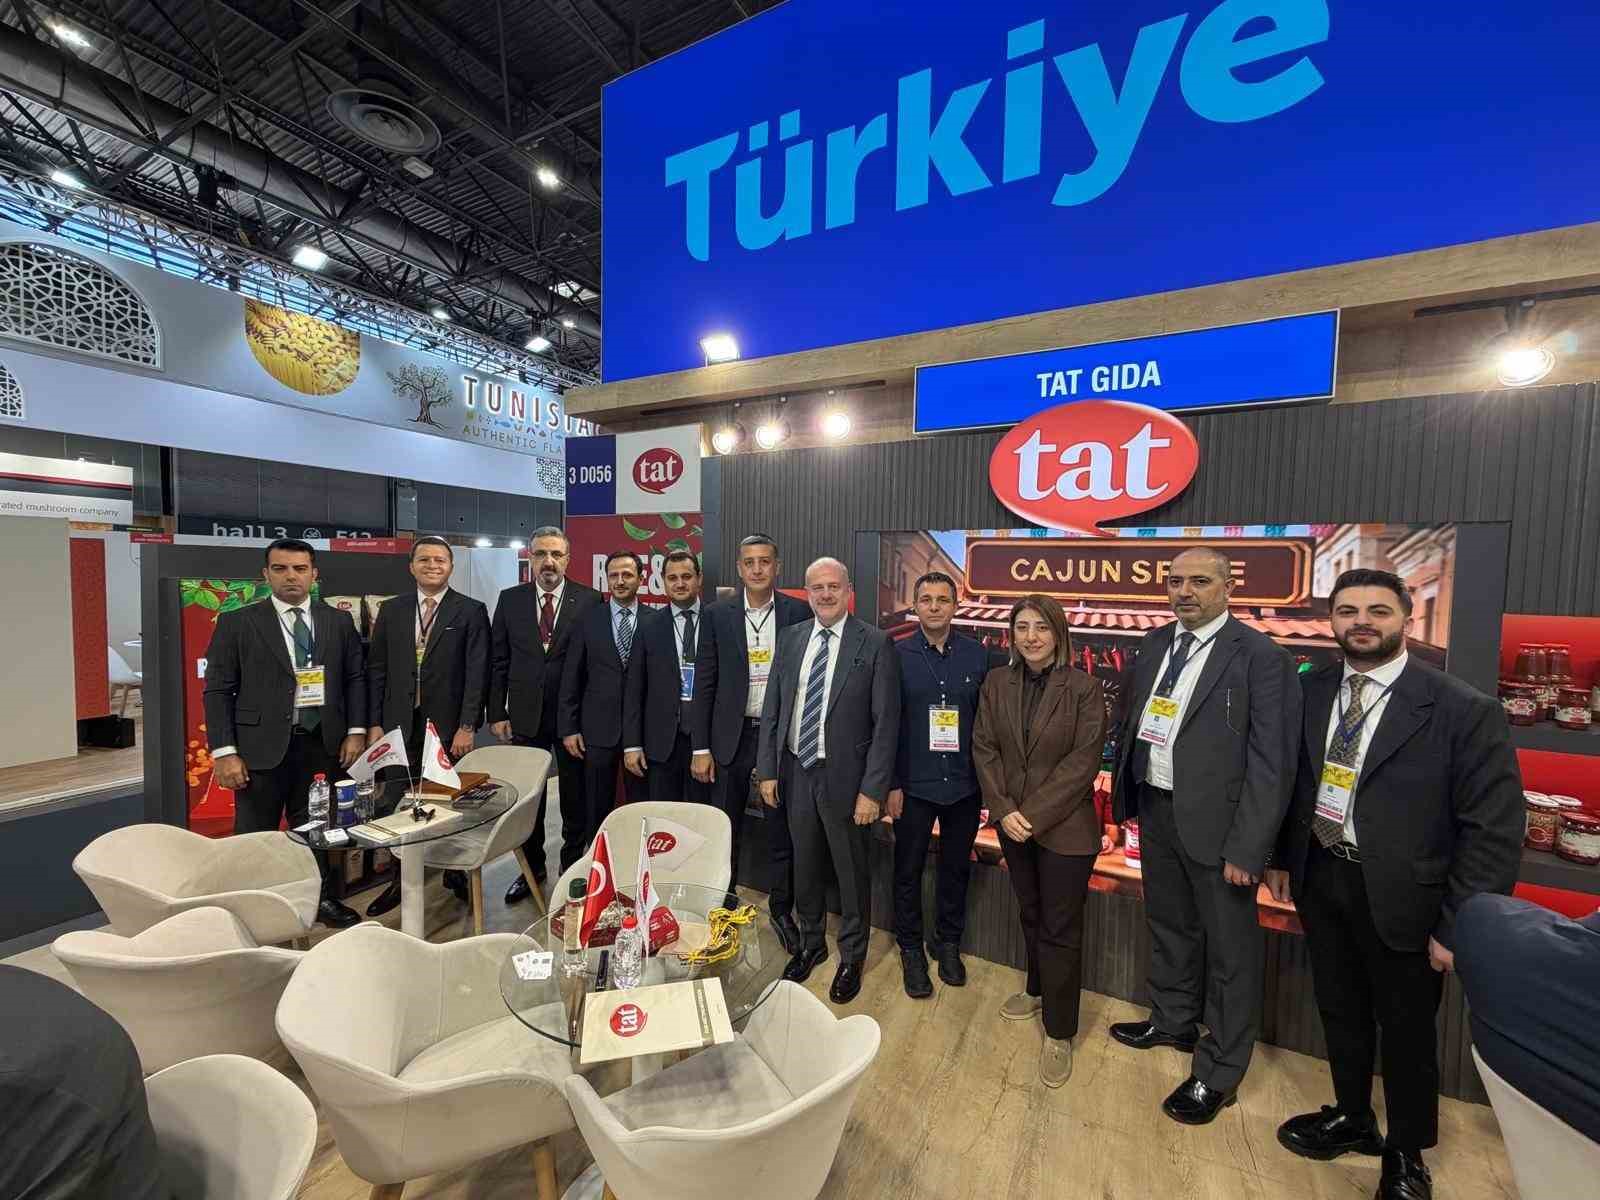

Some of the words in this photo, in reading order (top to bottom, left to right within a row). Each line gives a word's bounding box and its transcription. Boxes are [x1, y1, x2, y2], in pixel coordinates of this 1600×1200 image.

[664, 0, 1330, 262] Türkiye
[1036, 368, 1083, 398] TAT
[1091, 360, 1161, 393] GIDA
[463, 425, 537, 449] AUTHENTIC
[569, 467, 577, 484] 3
[580, 465, 612, 484] D056
[639, 455, 677, 483] tat
[1013, 422, 1171, 501] tat
[26, 502, 77, 514] mushroom
[212, 522, 265, 539] hall
[1010, 558, 1121, 584] CAJUN
[1131, 559, 1246, 586] SPE
[618, 1007, 638, 1033] tat
